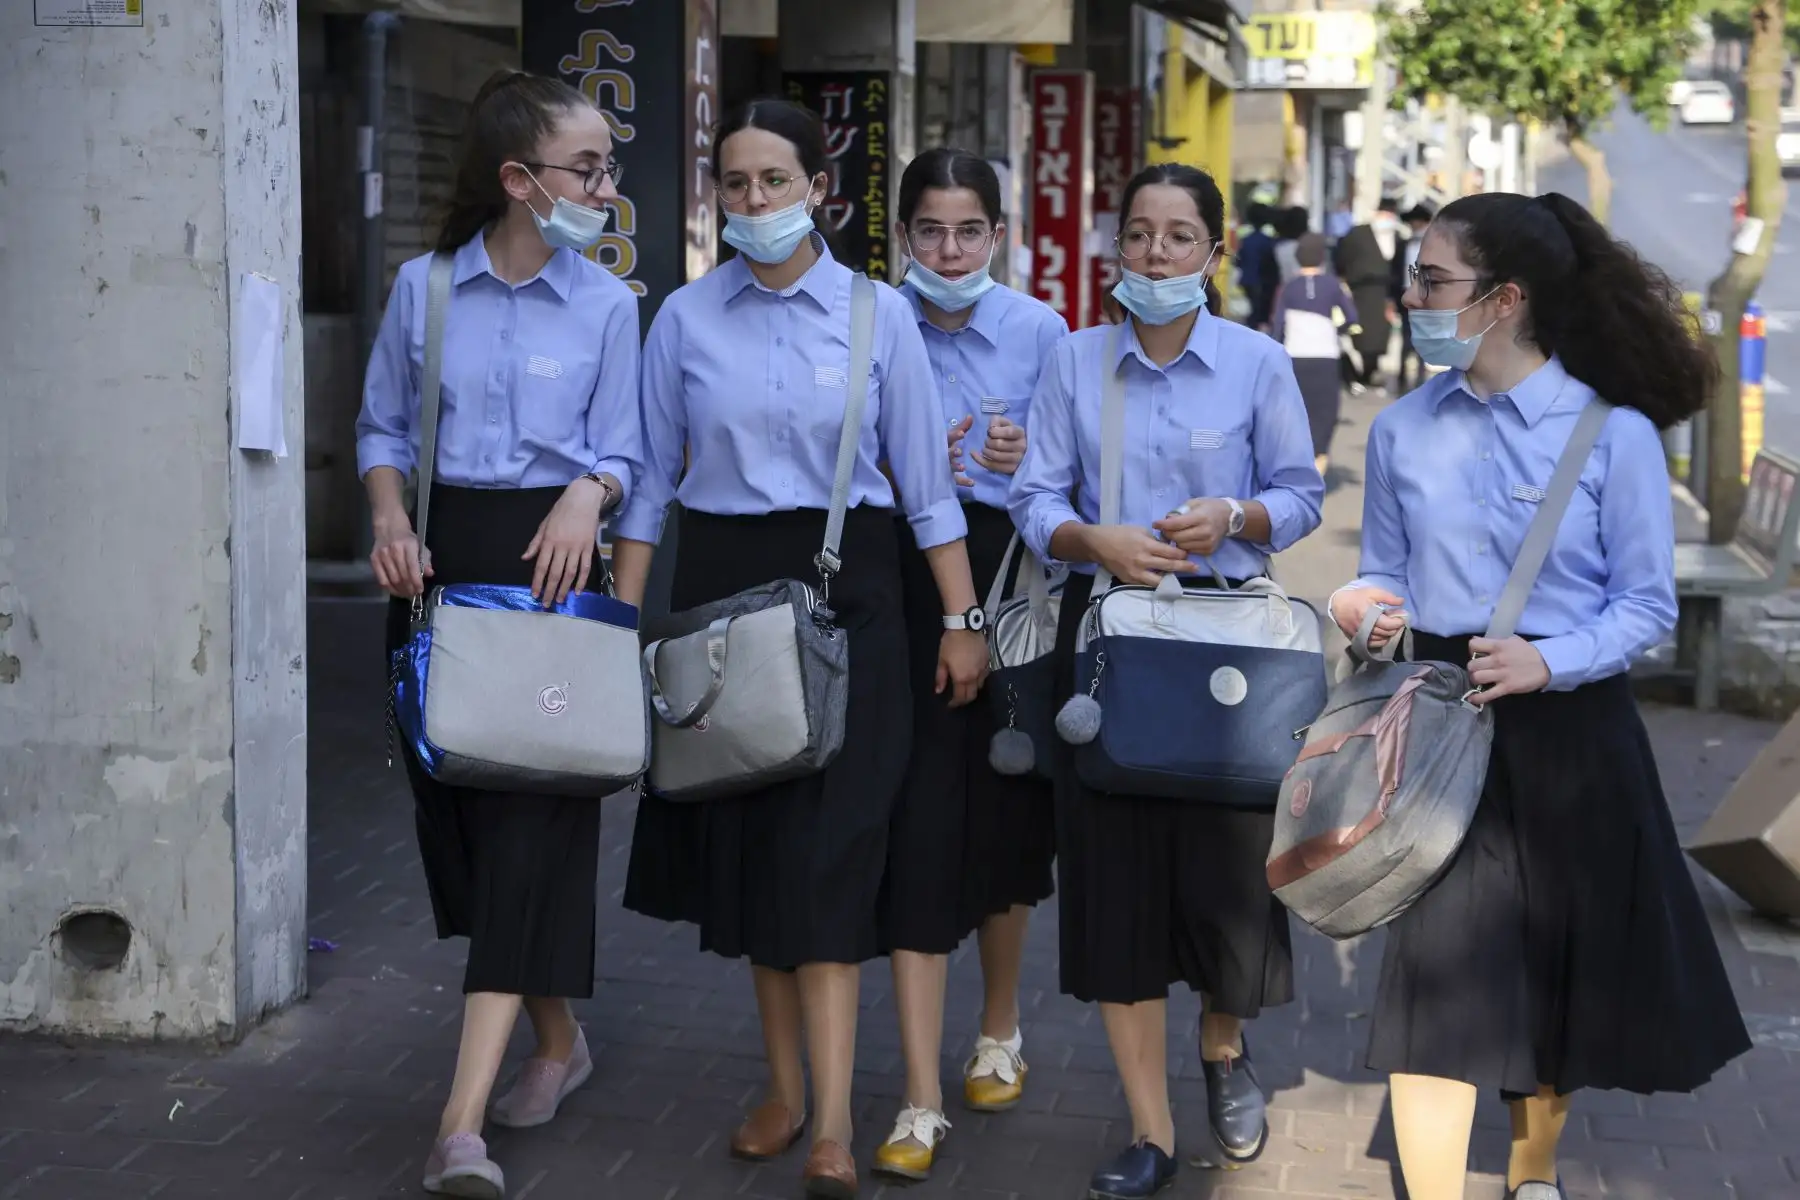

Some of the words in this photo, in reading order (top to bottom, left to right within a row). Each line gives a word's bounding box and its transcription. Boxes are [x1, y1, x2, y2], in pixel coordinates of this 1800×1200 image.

[862, 79, 885, 112] כלי
[867, 121, 885, 159] בית
[1036, 83, 1071, 218] בזאר
[862, 175, 886, 240] וילונות
[1039, 234, 1068, 312] לב
